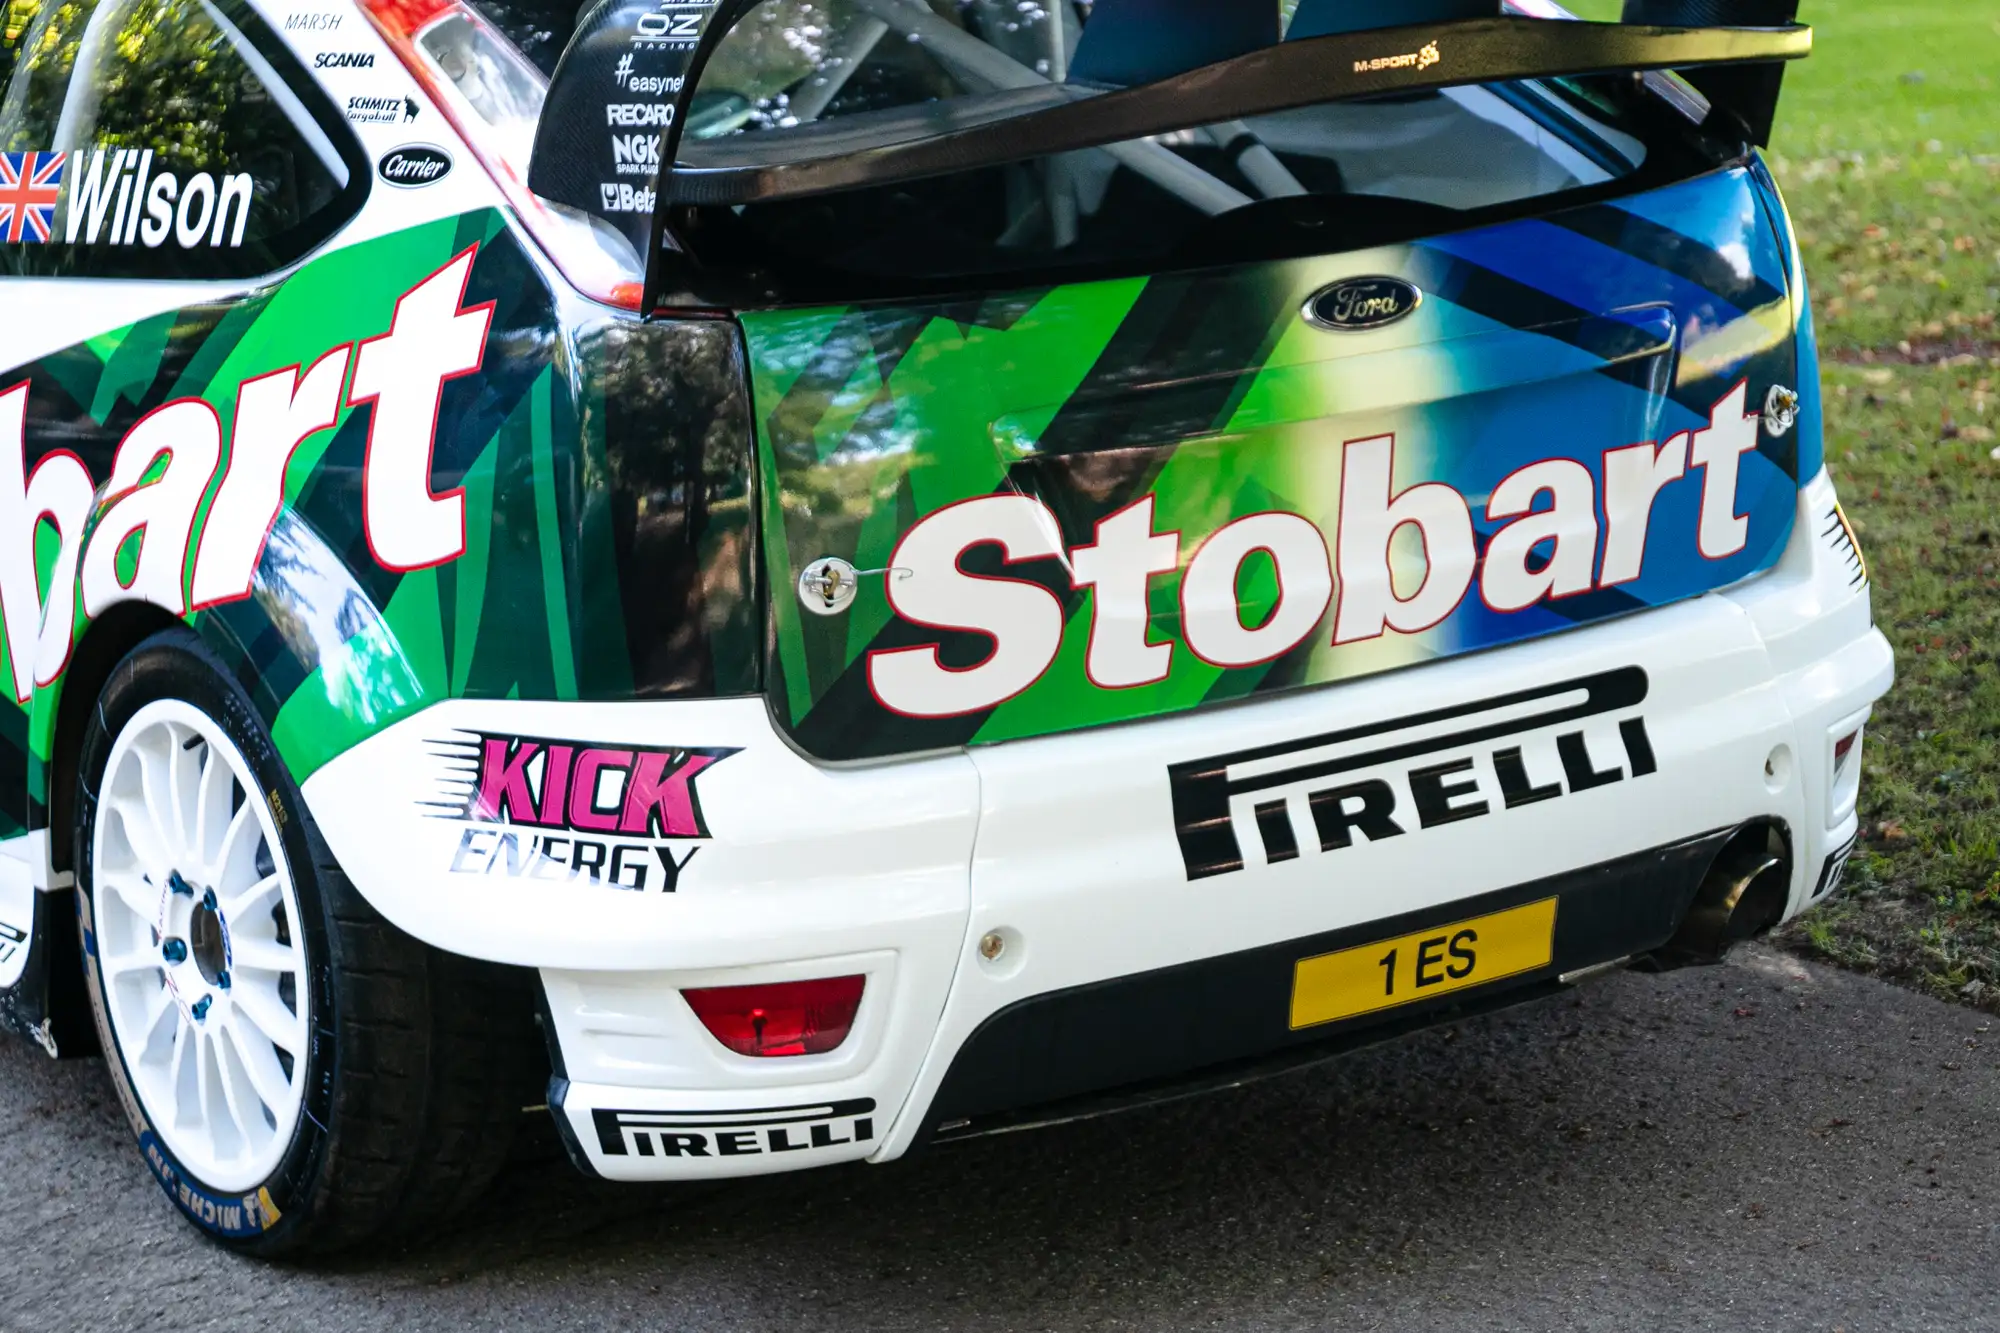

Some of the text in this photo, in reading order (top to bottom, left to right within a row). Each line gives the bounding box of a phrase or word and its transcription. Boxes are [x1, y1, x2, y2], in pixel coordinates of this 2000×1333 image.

[285, 14, 343, 30] MARSH
[314, 52, 375, 68] SCANIA
[633, 42, 695, 50] RACING
[1353, 53, 1418, 72] M-SPORT
[346, 110, 397, 122] Cargobull
[347, 96, 401, 111] SCHMITZ
[606, 103, 675, 127] RECARO
[612, 134, 660, 164] NGK
[385, 154, 445, 179] Carrier
[616, 163, 640, 175] SPARK
[65, 149, 254, 249] Wilson
[619, 183, 656, 214] Beta
[1334, 284, 1398, 321] Ford
[866, 377, 1759, 720] Stobart
[469, 731, 728, 839] KICK
[1167, 664, 1657, 881] PIRELLI
[449, 827, 702, 893] ENERGY
[1379, 929, 1478, 996] 1 ES
[591, 1097, 877, 1157] PIRELLI
